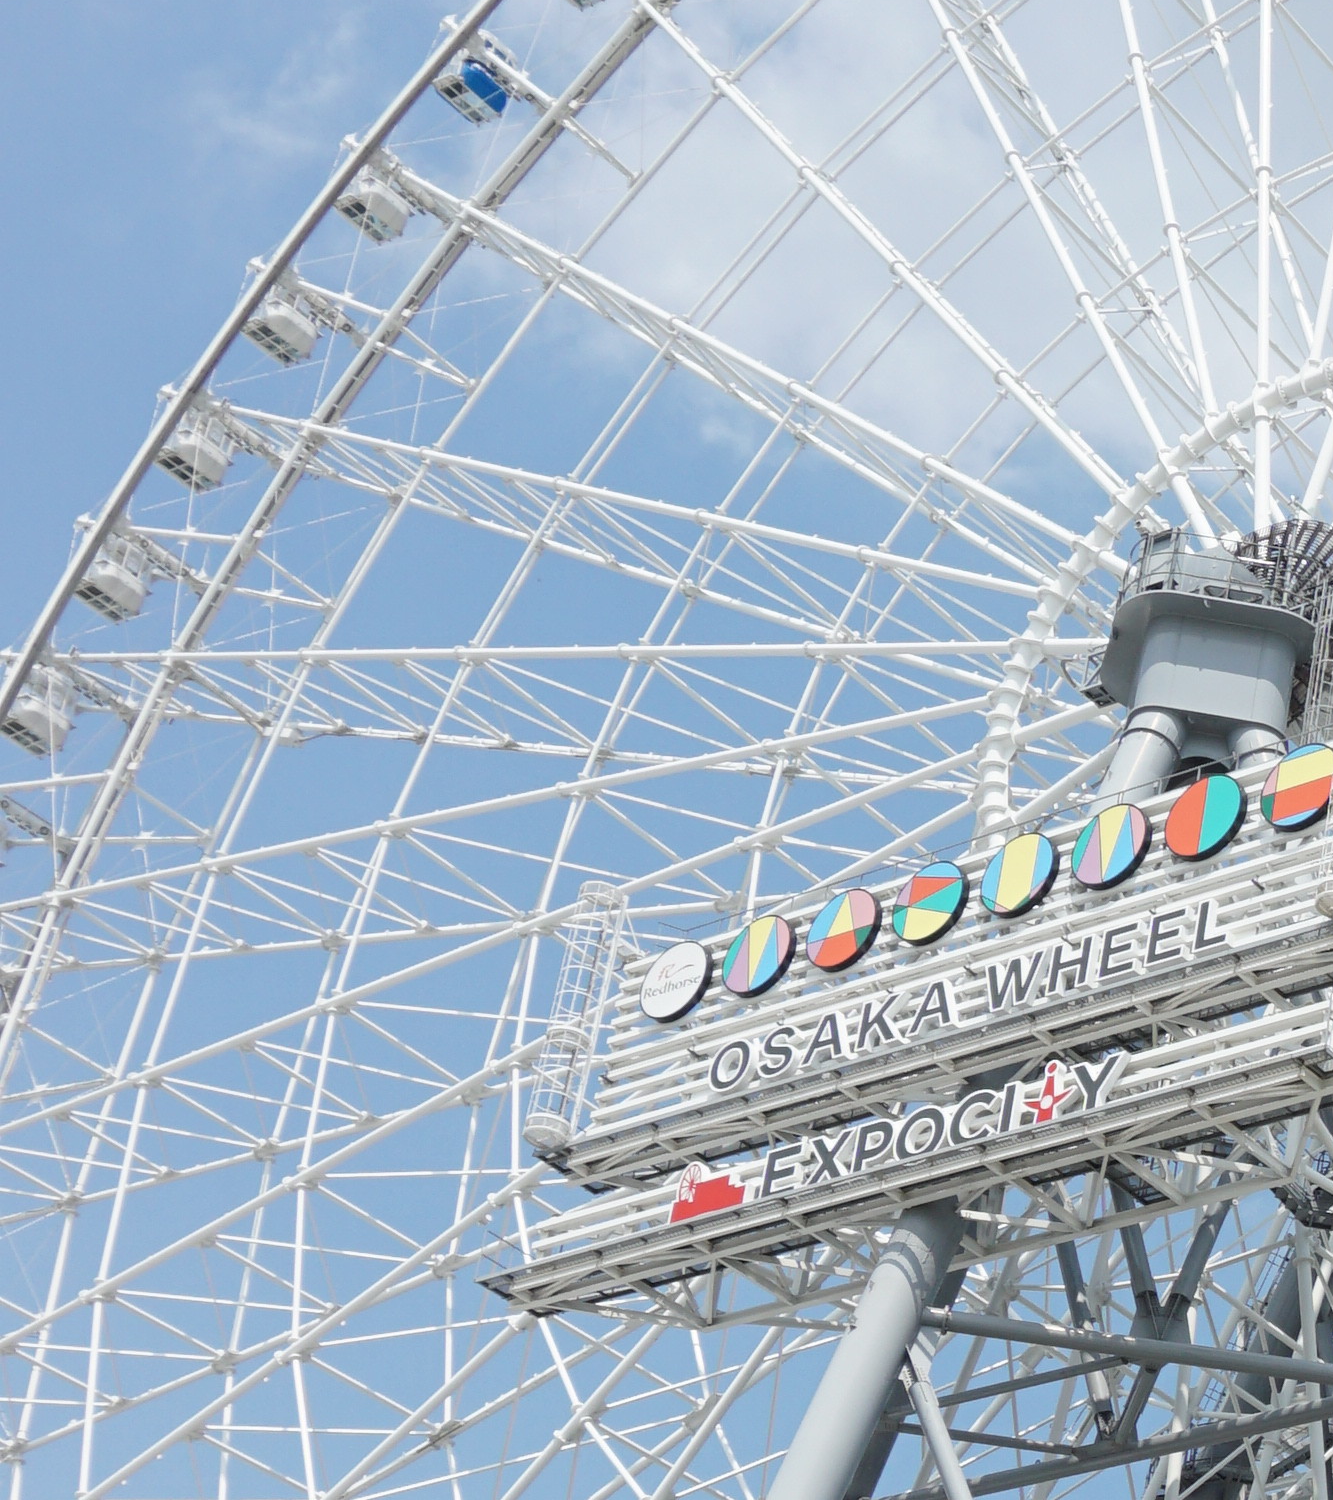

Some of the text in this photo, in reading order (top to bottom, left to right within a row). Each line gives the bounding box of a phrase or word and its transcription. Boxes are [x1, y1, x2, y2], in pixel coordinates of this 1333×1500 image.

[642, 974, 702, 1000] Redhorse
[708, 901, 1228, 1092] OSAKA WHEEL
[760, 1053, 1124, 1199] EXPOCITY
